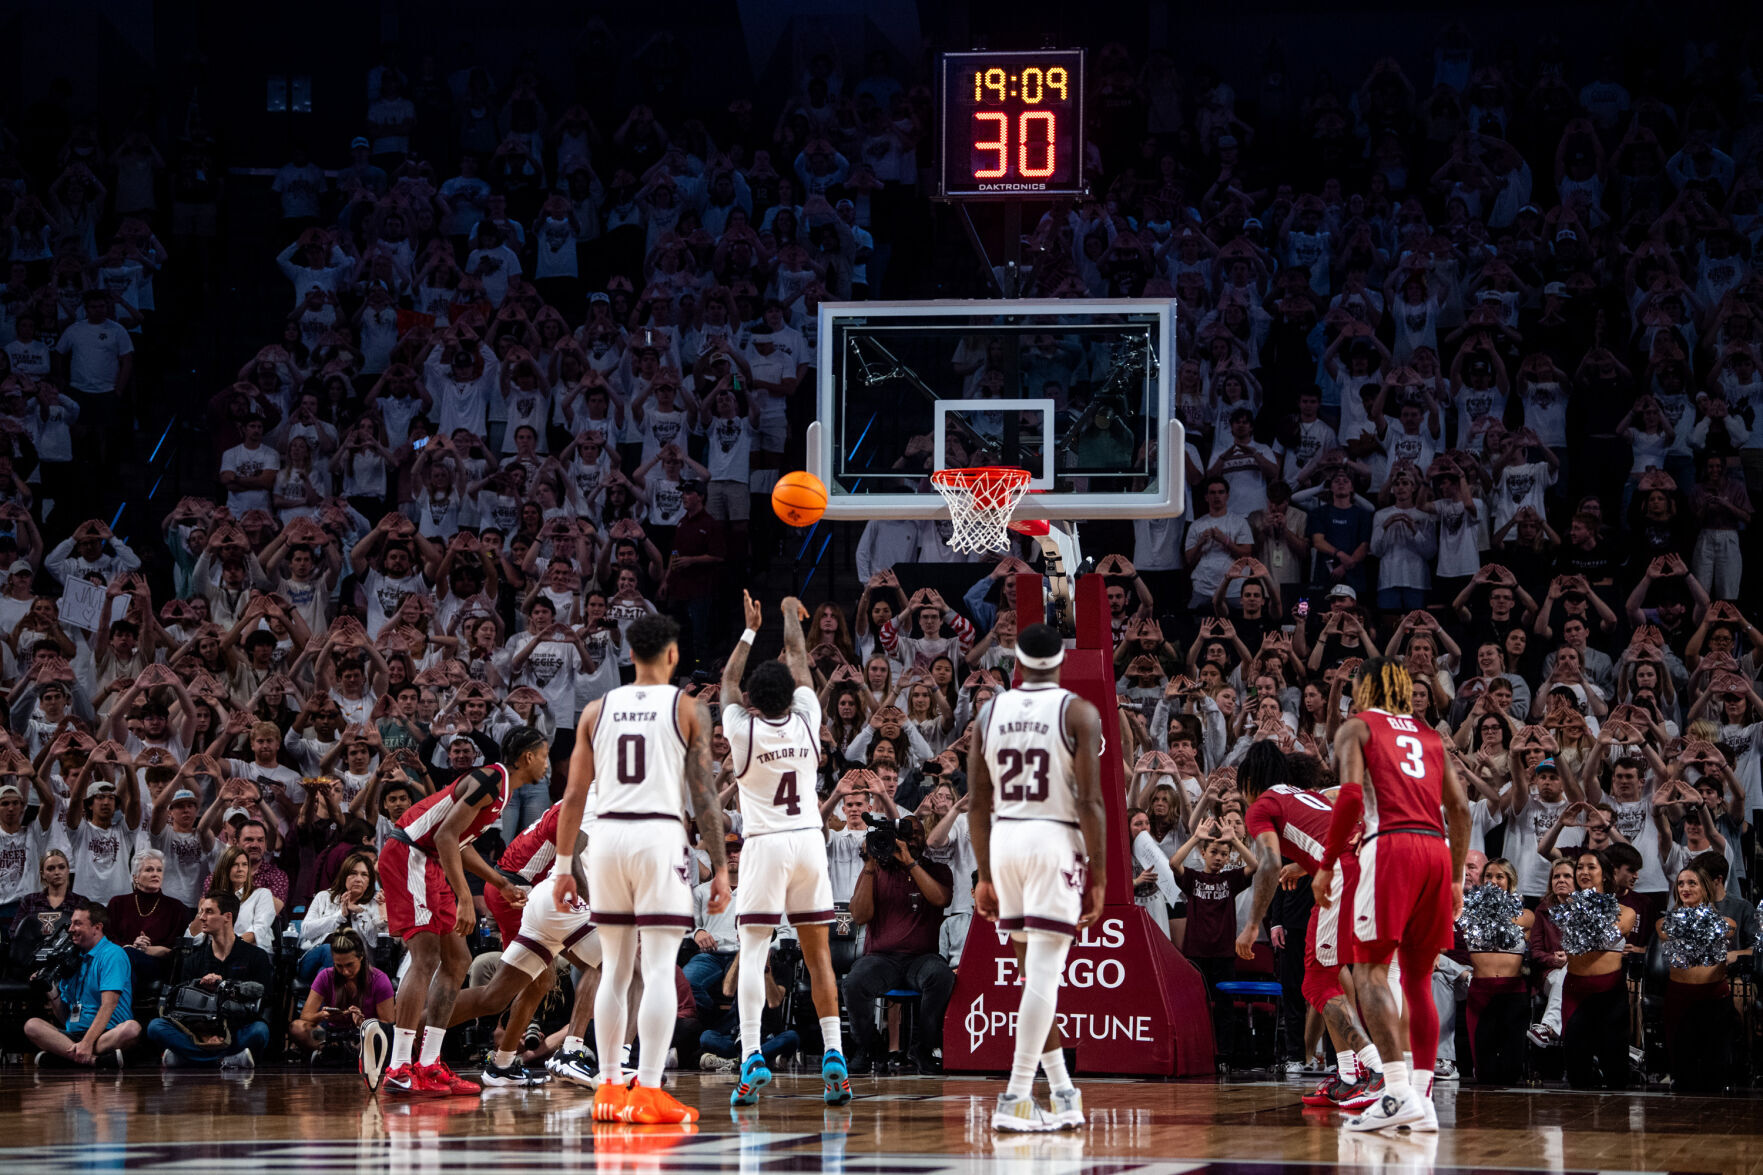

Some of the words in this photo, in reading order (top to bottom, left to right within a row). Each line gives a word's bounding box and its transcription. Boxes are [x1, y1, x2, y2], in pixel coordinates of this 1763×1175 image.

[975, 67, 1068, 104] 19:09
[974, 112, 1056, 177] 30
[978, 183, 1046, 191] DAKTRONICS
[613, 711, 657, 722] CARTER
[998, 721, 1050, 735] RADFORD
[617, 734, 646, 784] 0
[756, 747, 795, 765] TAYLOR
[799, 747, 810, 758] IV
[997, 748, 1050, 802] 23
[1396, 735, 1426, 779] 3
[773, 771, 801, 816] 4
